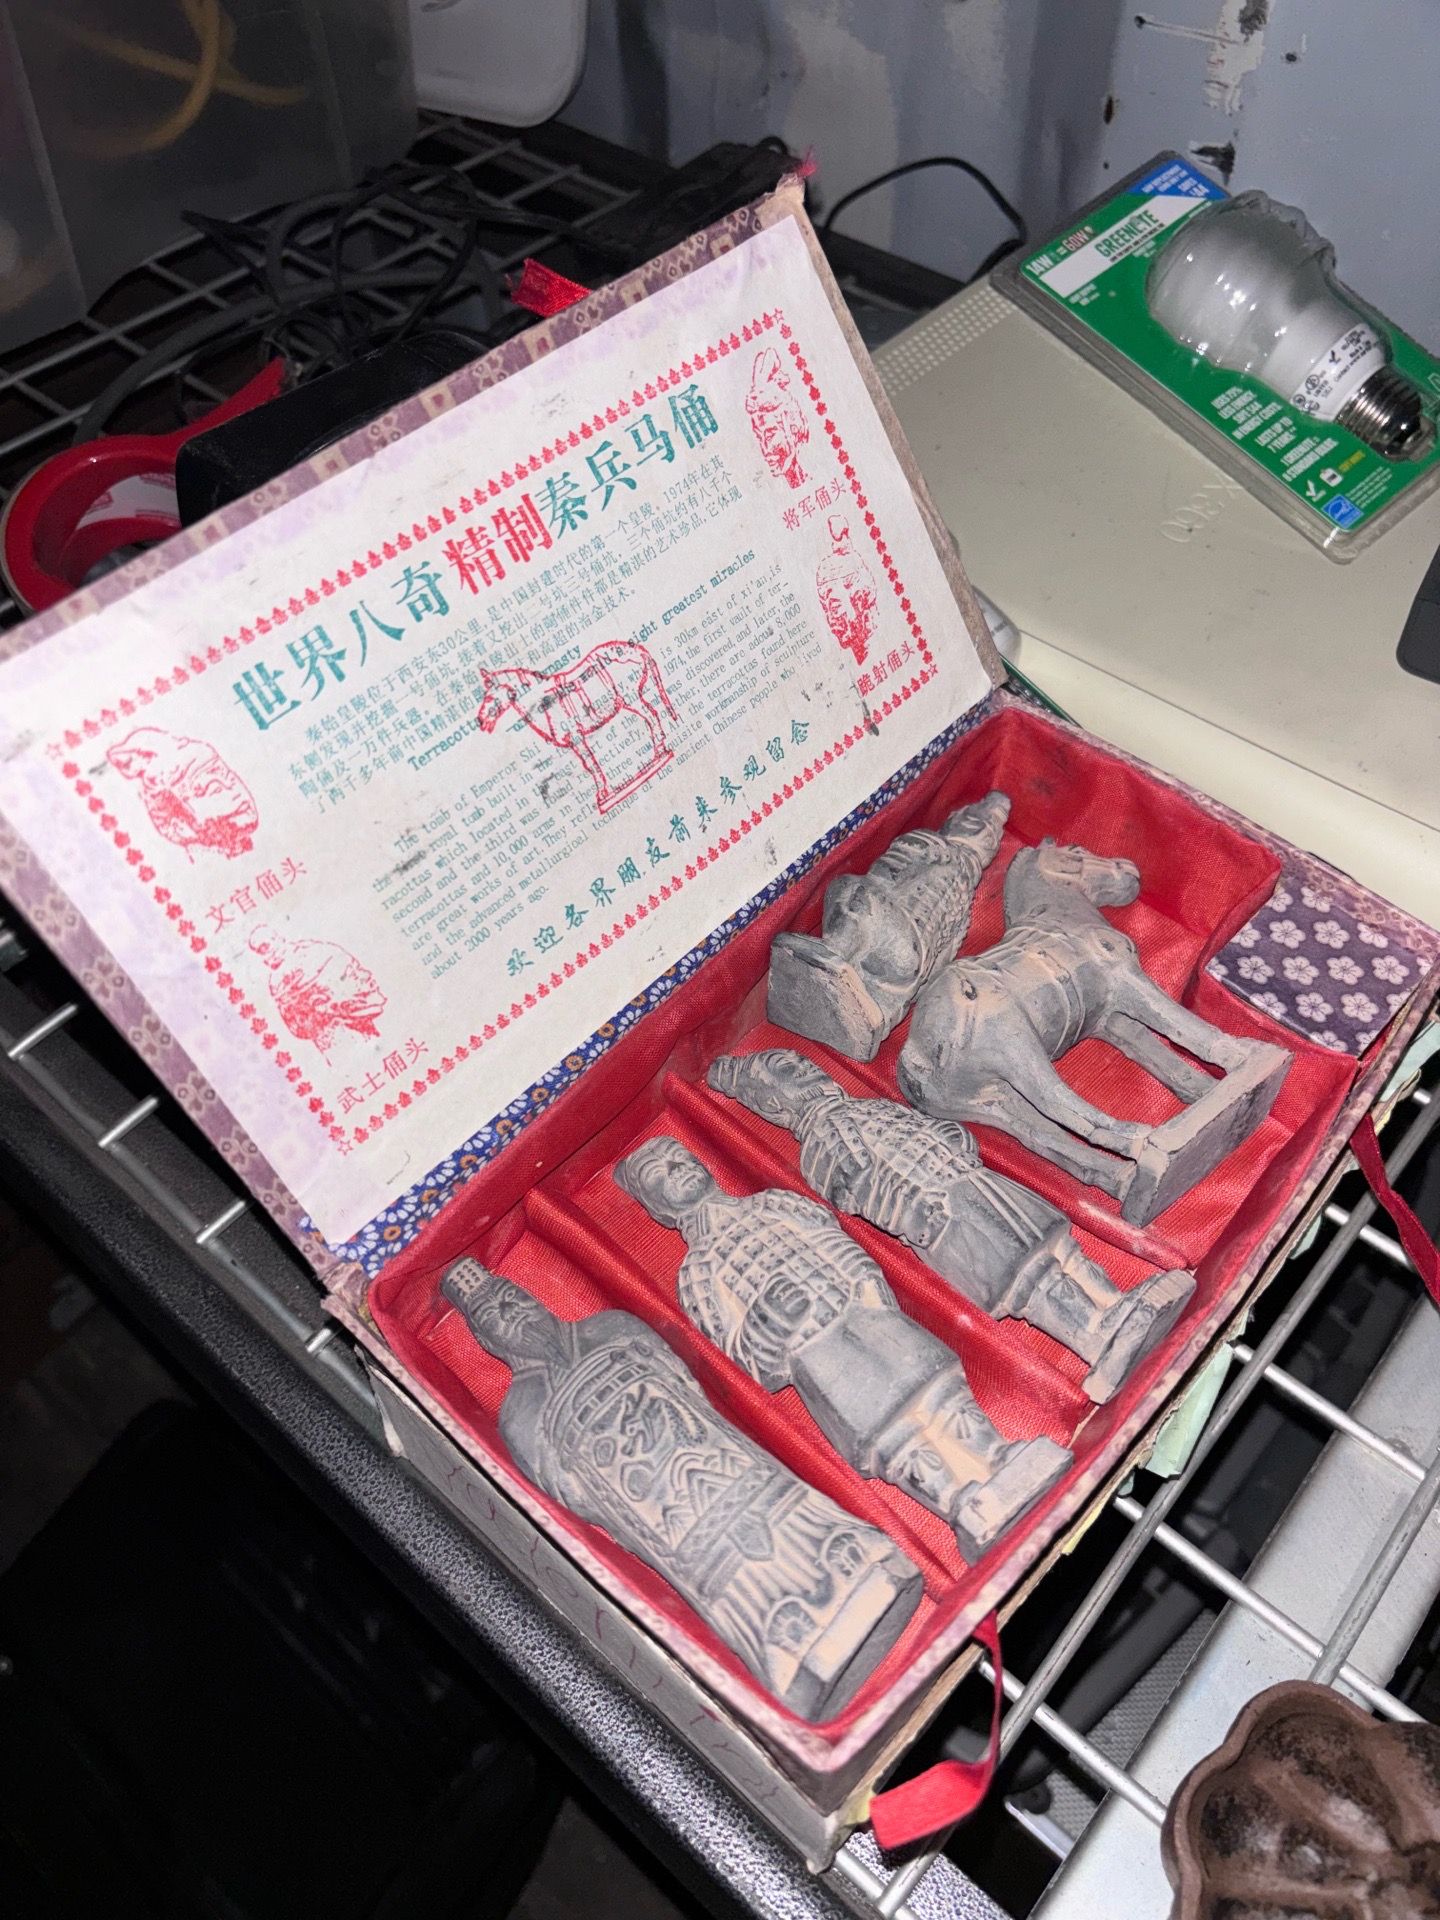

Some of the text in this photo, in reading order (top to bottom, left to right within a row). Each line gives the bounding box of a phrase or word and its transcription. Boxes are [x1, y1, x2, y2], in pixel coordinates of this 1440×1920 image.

[1063, 229, 1090, 251] 60W
[780, 474, 847, 533] 将军俑头
[658, 582, 709, 626] greatest
[707, 546, 756, 589] miracles
[855, 637, 916, 697] 跪射俑头
[370, 871, 393, 893] the
[426, 823, 460, 854] royal
[459, 803, 486, 828] tomb
[485, 780, 517, 809] built
[519, 768, 534, 784] in
[684, 641, 701, 660] the
[702, 622, 727, 647] first
[727, 603, 752, 627] vault
[752, 592, 766, 608] of
[379, 866, 433, 910] racottas
[432, 839, 468, 871] which
[469, 805, 512, 844] located
[514, 792, 529, 810] in
[603, 725, 619, 742] of
[620, 710, 638, 729] the
[779, 589, 795, 608] the
[392, 828, 420, 855] The
[420, 805, 453, 835] tomb
[451, 792, 470, 812] of
[469, 757, 520, 801] Emperor
[518, 740, 541, 763] Shi
[659, 642, 673, 659] is
[699, 605, 724, 629] east
[724, 593, 739, 610] of
[406, 711, 485, 773] Terracotta
[389, 885, 434, 923] second
[434, 866, 458, 890] and
[459, 848, 483, 871] the
[483, 821, 517, 853] third
[518, 805, 540, 827] was
[698, 661, 727, 688] there
[727, 647, 746, 666] are
[400, 882, 469, 939] terracottas
[468, 863, 492, 886] and
[531, 815, 557, 839] arms
[558, 801, 572, 817] in
[604, 753, 633, 781] three
[686, 696, 705, 716] the
[705, 656, 759, 702] terracottas
[759, 633, 786, 660] found
[785, 617, 808, 640] here
[409, 928, 433, 952] are
[434, 902, 469, 934] great
[468, 874, 503, 906] works
[503, 860, 520, 879] of
[702, 672, 759, 722] workmanship
[758, 661, 771, 678] of
[771, 627, 816, 668] sculpture
[419, 942, 443, 966] and
[444, 924, 466, 946] the
[466, 884, 517, 929] advanced
[673, 731, 711, 766] ancient
[711, 701, 748, 736] Chinese
[747, 676, 779, 708] people
[778, 662, 796, 681] who
[200, 849, 309, 935] 文官俑头
[427, 947, 463, 980] about
[462, 923, 492, 952] 2000
[492, 900, 526, 932] years
[333, 1031, 430, 1116] 武士俑头
